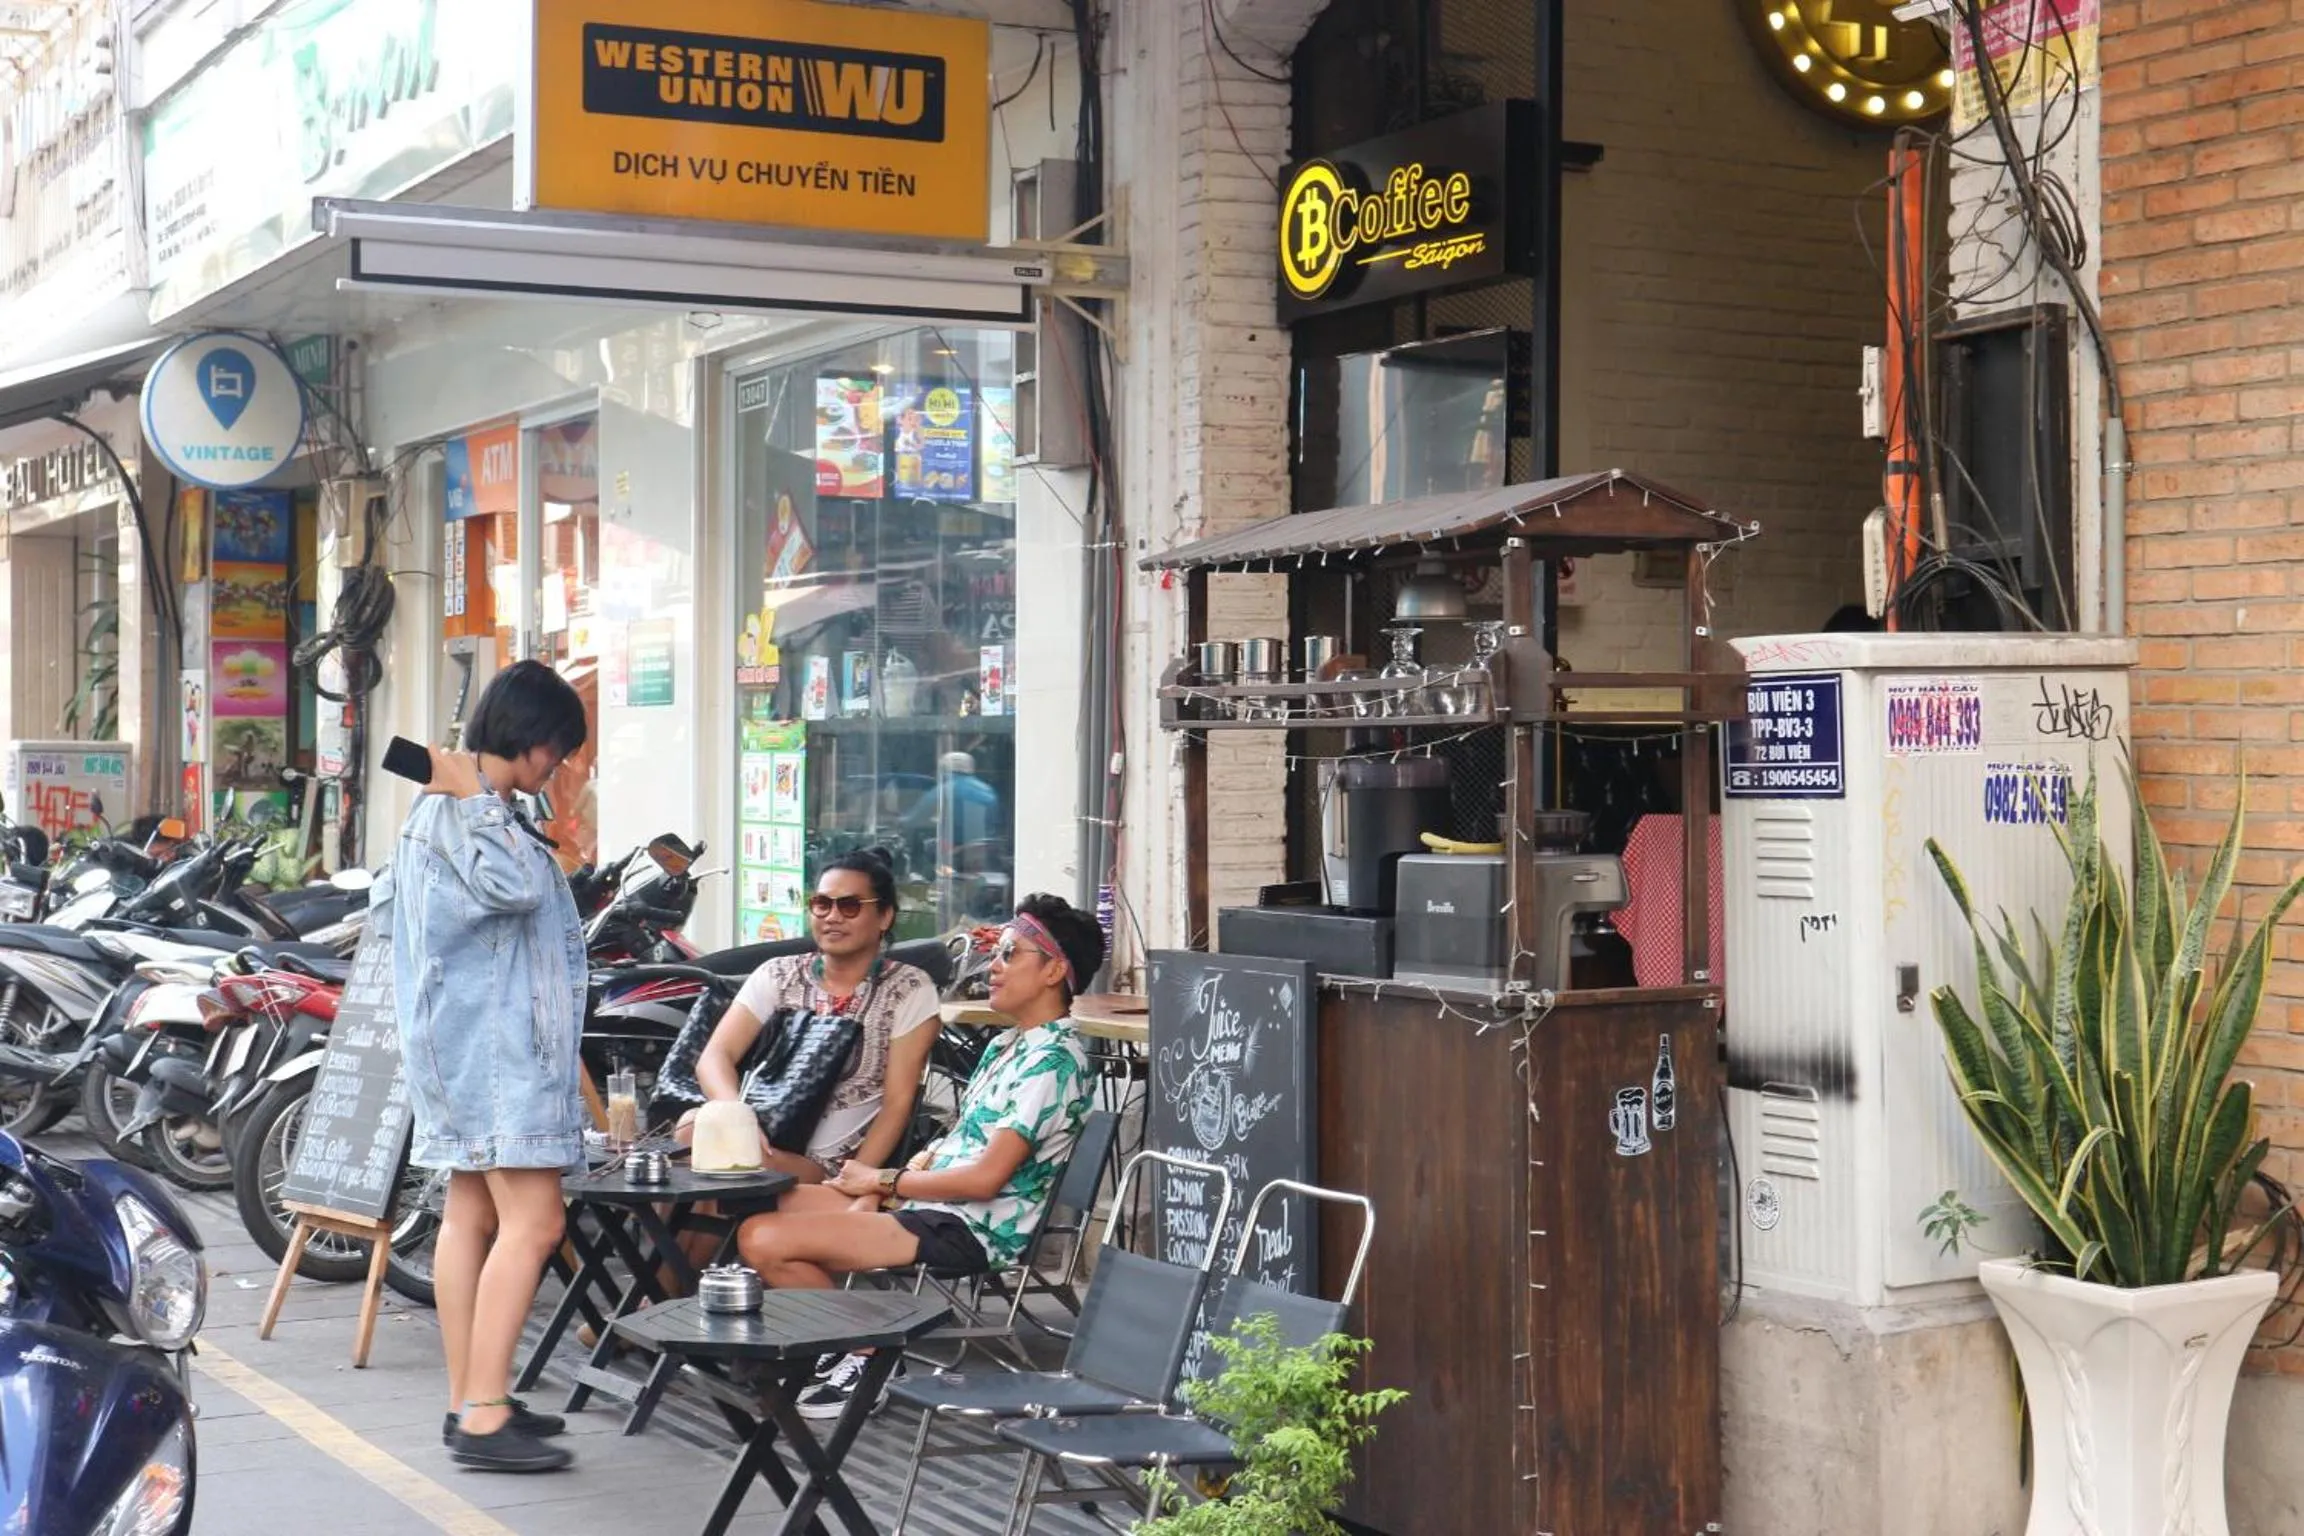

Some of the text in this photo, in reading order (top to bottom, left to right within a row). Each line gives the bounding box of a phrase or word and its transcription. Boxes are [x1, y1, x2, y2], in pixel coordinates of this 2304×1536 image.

[595, 40, 793, 81] WESTERN
[659, 77, 793, 114] UNION
[819, 62, 927, 126] WU
[614, 150, 916, 197] DỊCH VỤ CHUYỂN TIỀN
[1328, 162, 1471, 254] Coffee
[1404, 237, 1487, 271] Saigon
[182, 444, 275, 463] VINTAGE
[481, 441, 514, 486] ATM
[1747, 686, 1815, 717] BÙI VIỆN 3
[1751, 716, 1814, 739] TPP-BV3-3
[1754, 744, 1767, 761] 72
[1761, 769, 1838, 787] 1900545454
[1984, 773, 2070, 825] 0982.506.59
